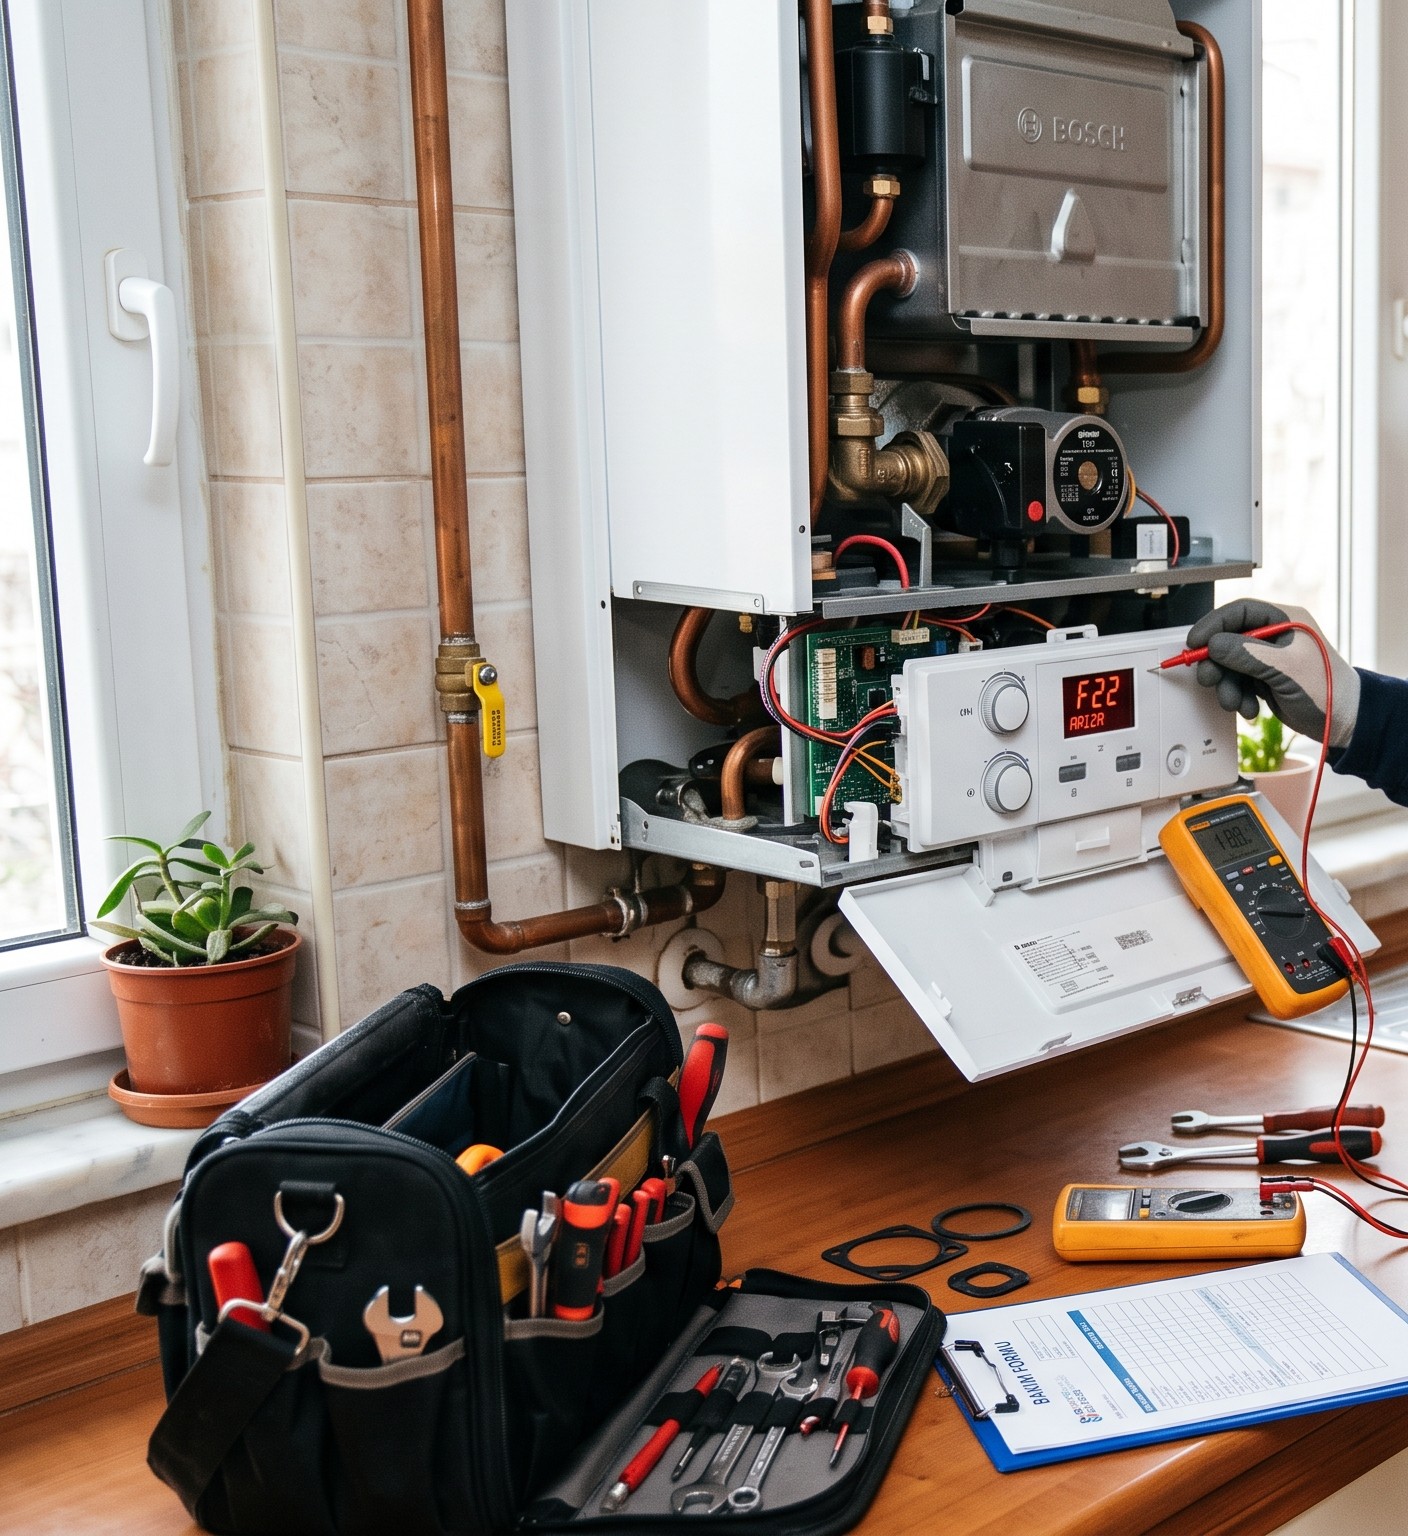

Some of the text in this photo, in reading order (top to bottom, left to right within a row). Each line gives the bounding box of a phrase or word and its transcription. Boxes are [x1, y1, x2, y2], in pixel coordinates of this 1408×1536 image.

[1053, 116, 1125, 152] BOSCH
[1077, 675, 1120, 709] F22
[994, 1341, 1051, 1405] BAKIM FORMU
